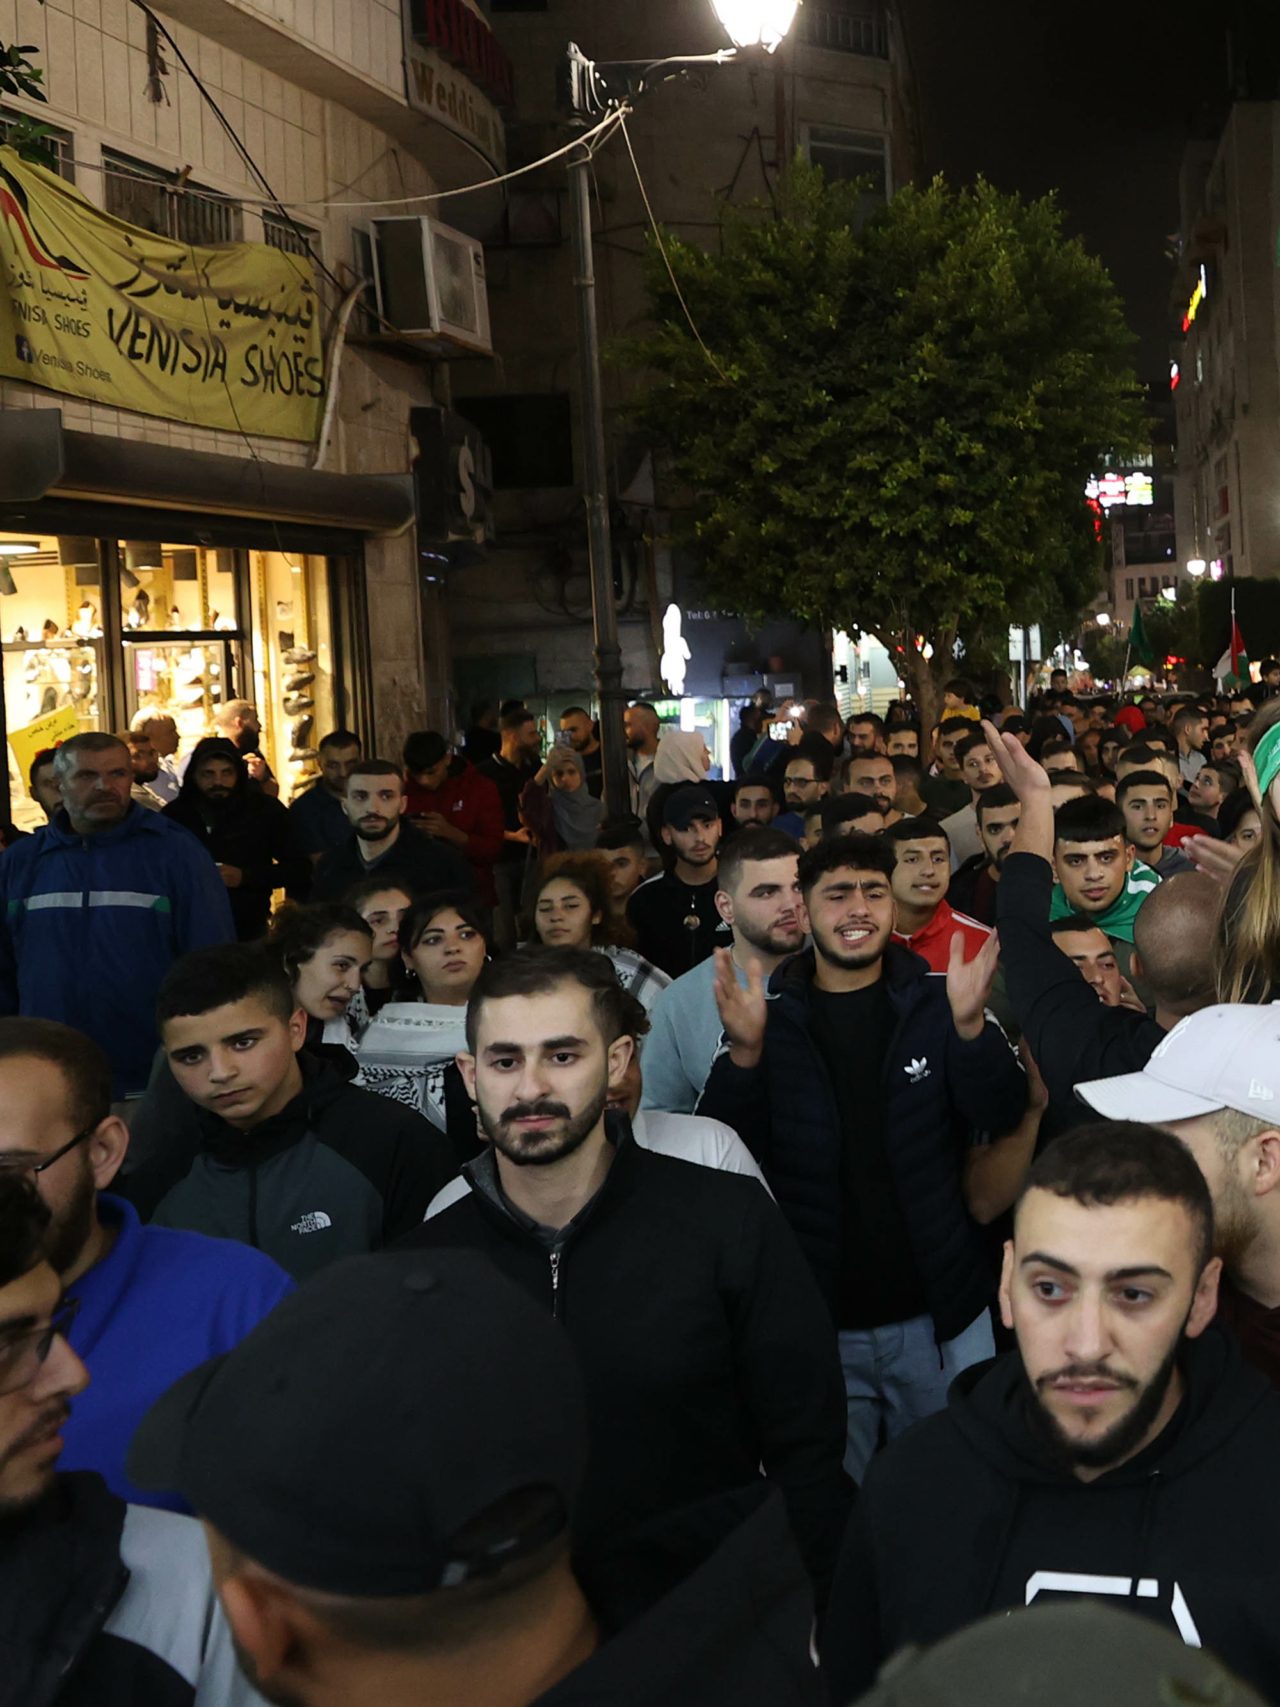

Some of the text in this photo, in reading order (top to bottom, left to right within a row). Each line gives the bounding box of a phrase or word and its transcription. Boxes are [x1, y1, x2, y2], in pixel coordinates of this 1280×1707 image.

[240, 344, 326, 398] SHOES
[301, 1211, 316, 1222] THE
[290, 1218, 317, 1232] NORTH
[299, 1225, 318, 1235] FACE
